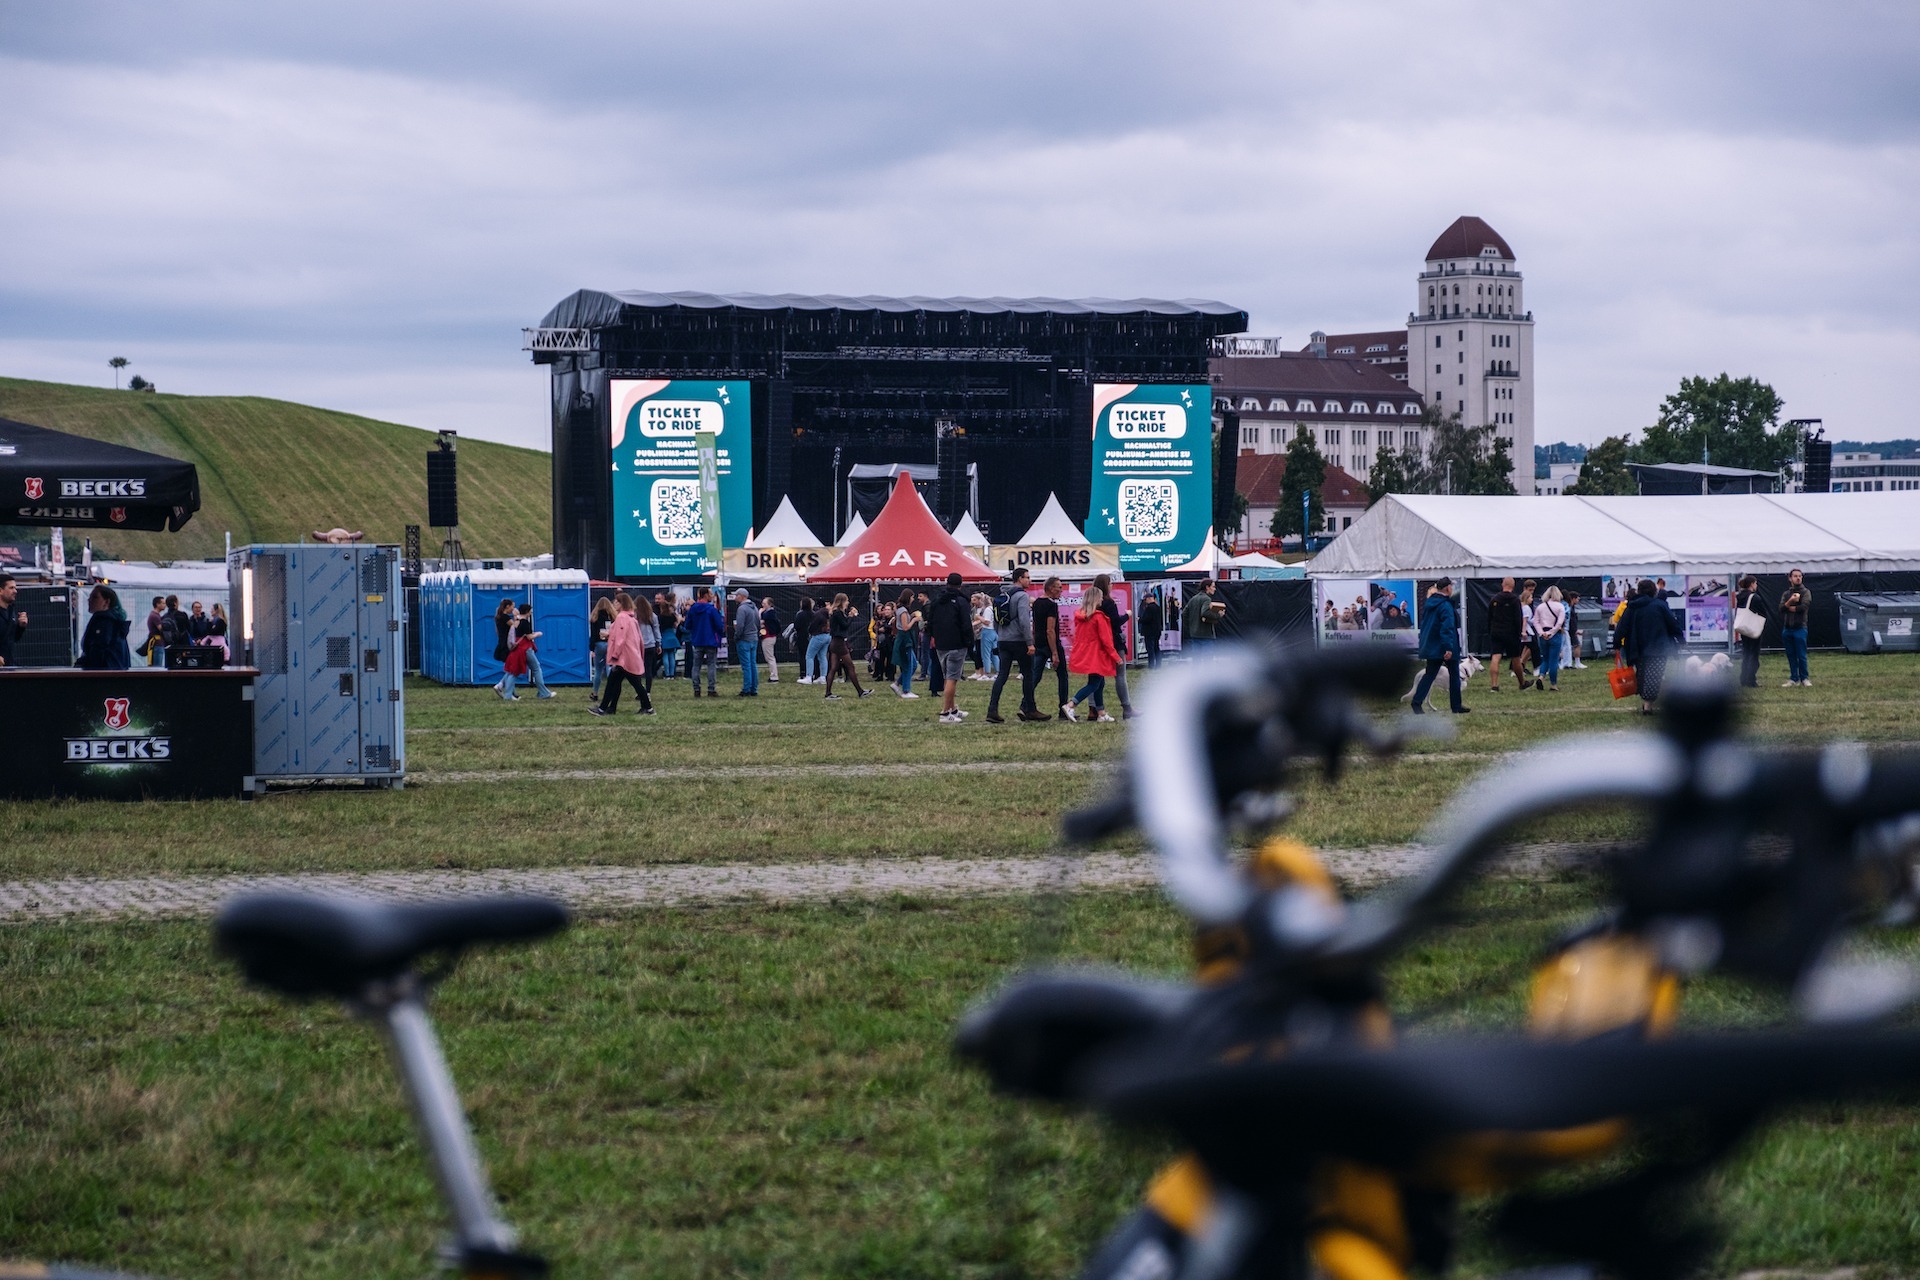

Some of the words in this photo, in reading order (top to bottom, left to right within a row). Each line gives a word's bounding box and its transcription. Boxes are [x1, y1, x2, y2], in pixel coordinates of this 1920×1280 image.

[648, 408, 702, 418] TICKET
[1117, 411, 1166, 421] TICKET
[648, 421, 667, 431] TO
[672, 421, 702, 431] RIDE
[1117, 423, 1134, 433] TO
[1139, 423, 1167, 433] RIDE
[656, 441, 696, 449] NACHHALT
[1124, 442, 1172, 450] NACHHALTIGE
[636, 450, 698, 458] PUBLIKUMS-AN
[60, 479, 145, 496] BECK'S
[746, 553, 820, 568] DRINKS
[858, 549, 948, 568] BAR
[1018, 550, 1091, 565] DRINKS
[1325, 632, 1353, 640] Kaffkiez
[1371, 632, 1397, 640] Provinz
[67, 737, 170, 759] BECK'S
